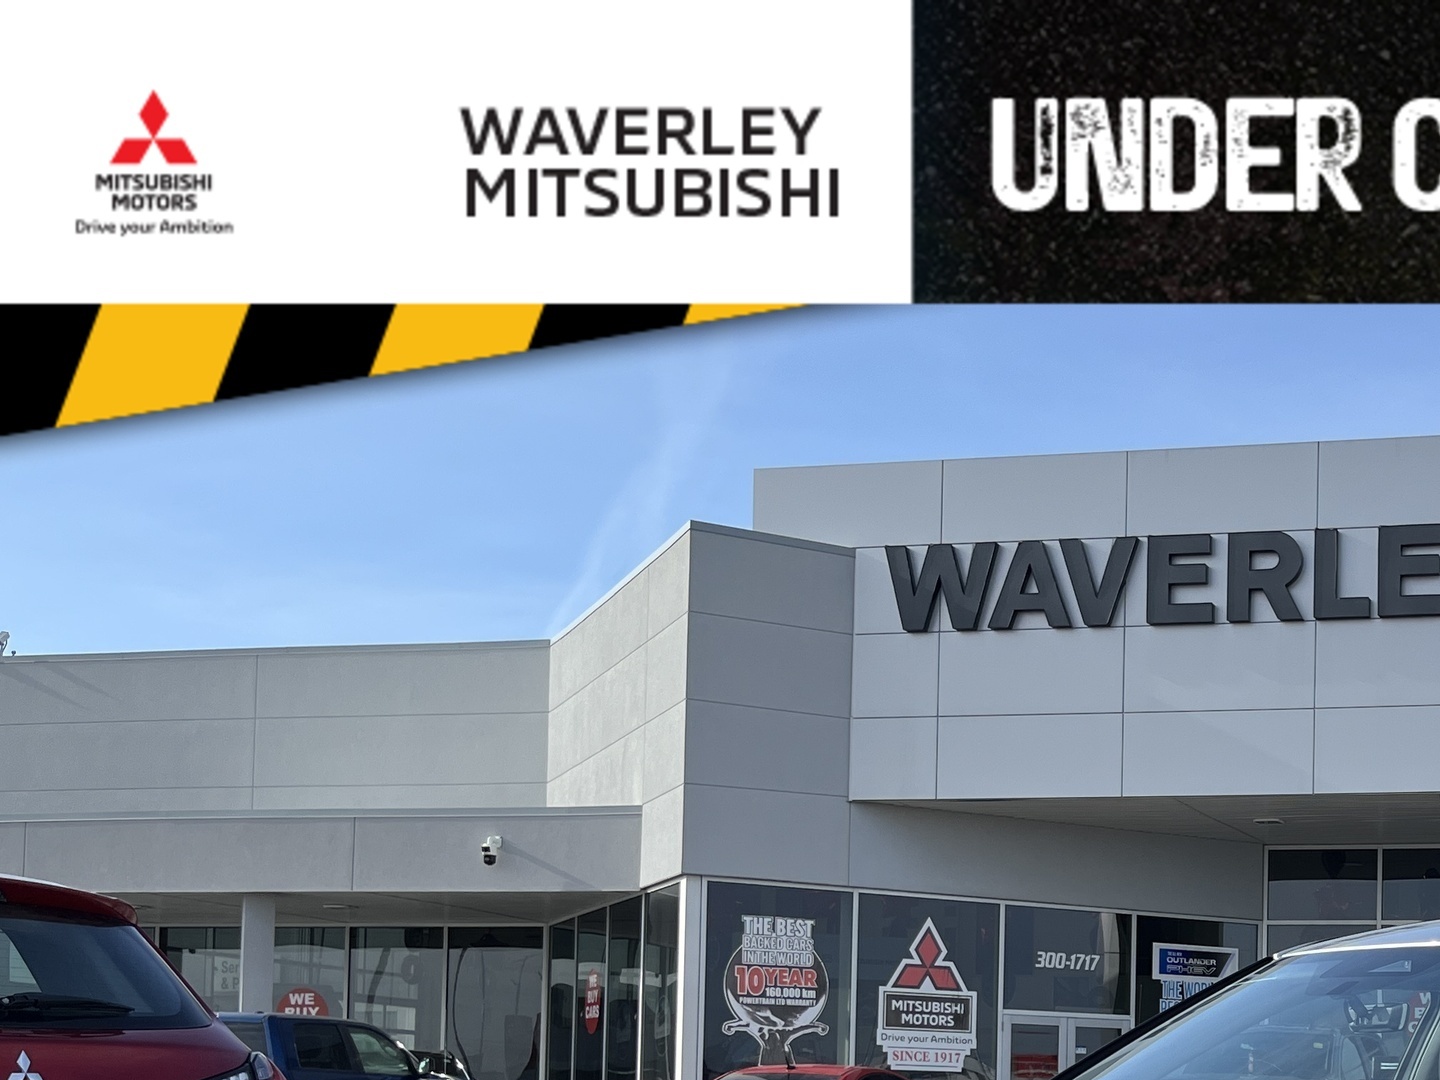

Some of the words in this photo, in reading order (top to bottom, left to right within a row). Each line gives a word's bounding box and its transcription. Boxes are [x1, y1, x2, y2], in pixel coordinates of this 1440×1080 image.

[743, 916, 773, 936] THE
[776, 917, 815, 938] BEST
[744, 936, 785, 950] BACKED
[786, 939, 814, 952] CARS
[744, 950, 754, 963] IN
[755, 951, 776, 965] THE
[777, 952, 814, 966] WORLD
[1035, 951, 1100, 971] 300-1717
[1166, 956, 1217, 966] OUTLANDER
[735, 966, 765, 995] 10
[763, 968, 818, 988] YEAR
[765, 988, 800, 998] 160,000
[802, 989, 816, 998] km
[1162, 980, 1182, 998] THE
[289, 993, 315, 1005] WE
[891, 1000, 965, 1014] MITSUBISHI
[901, 1014, 955, 1027] MOTORS
[881, 1033, 905, 1042] Drive
[908, 1036, 929, 1044] your
[930, 1035, 973, 1045] Ambition
[892, 1050, 930, 1062] SINCE
[935, 1052, 961, 1064] 1917
